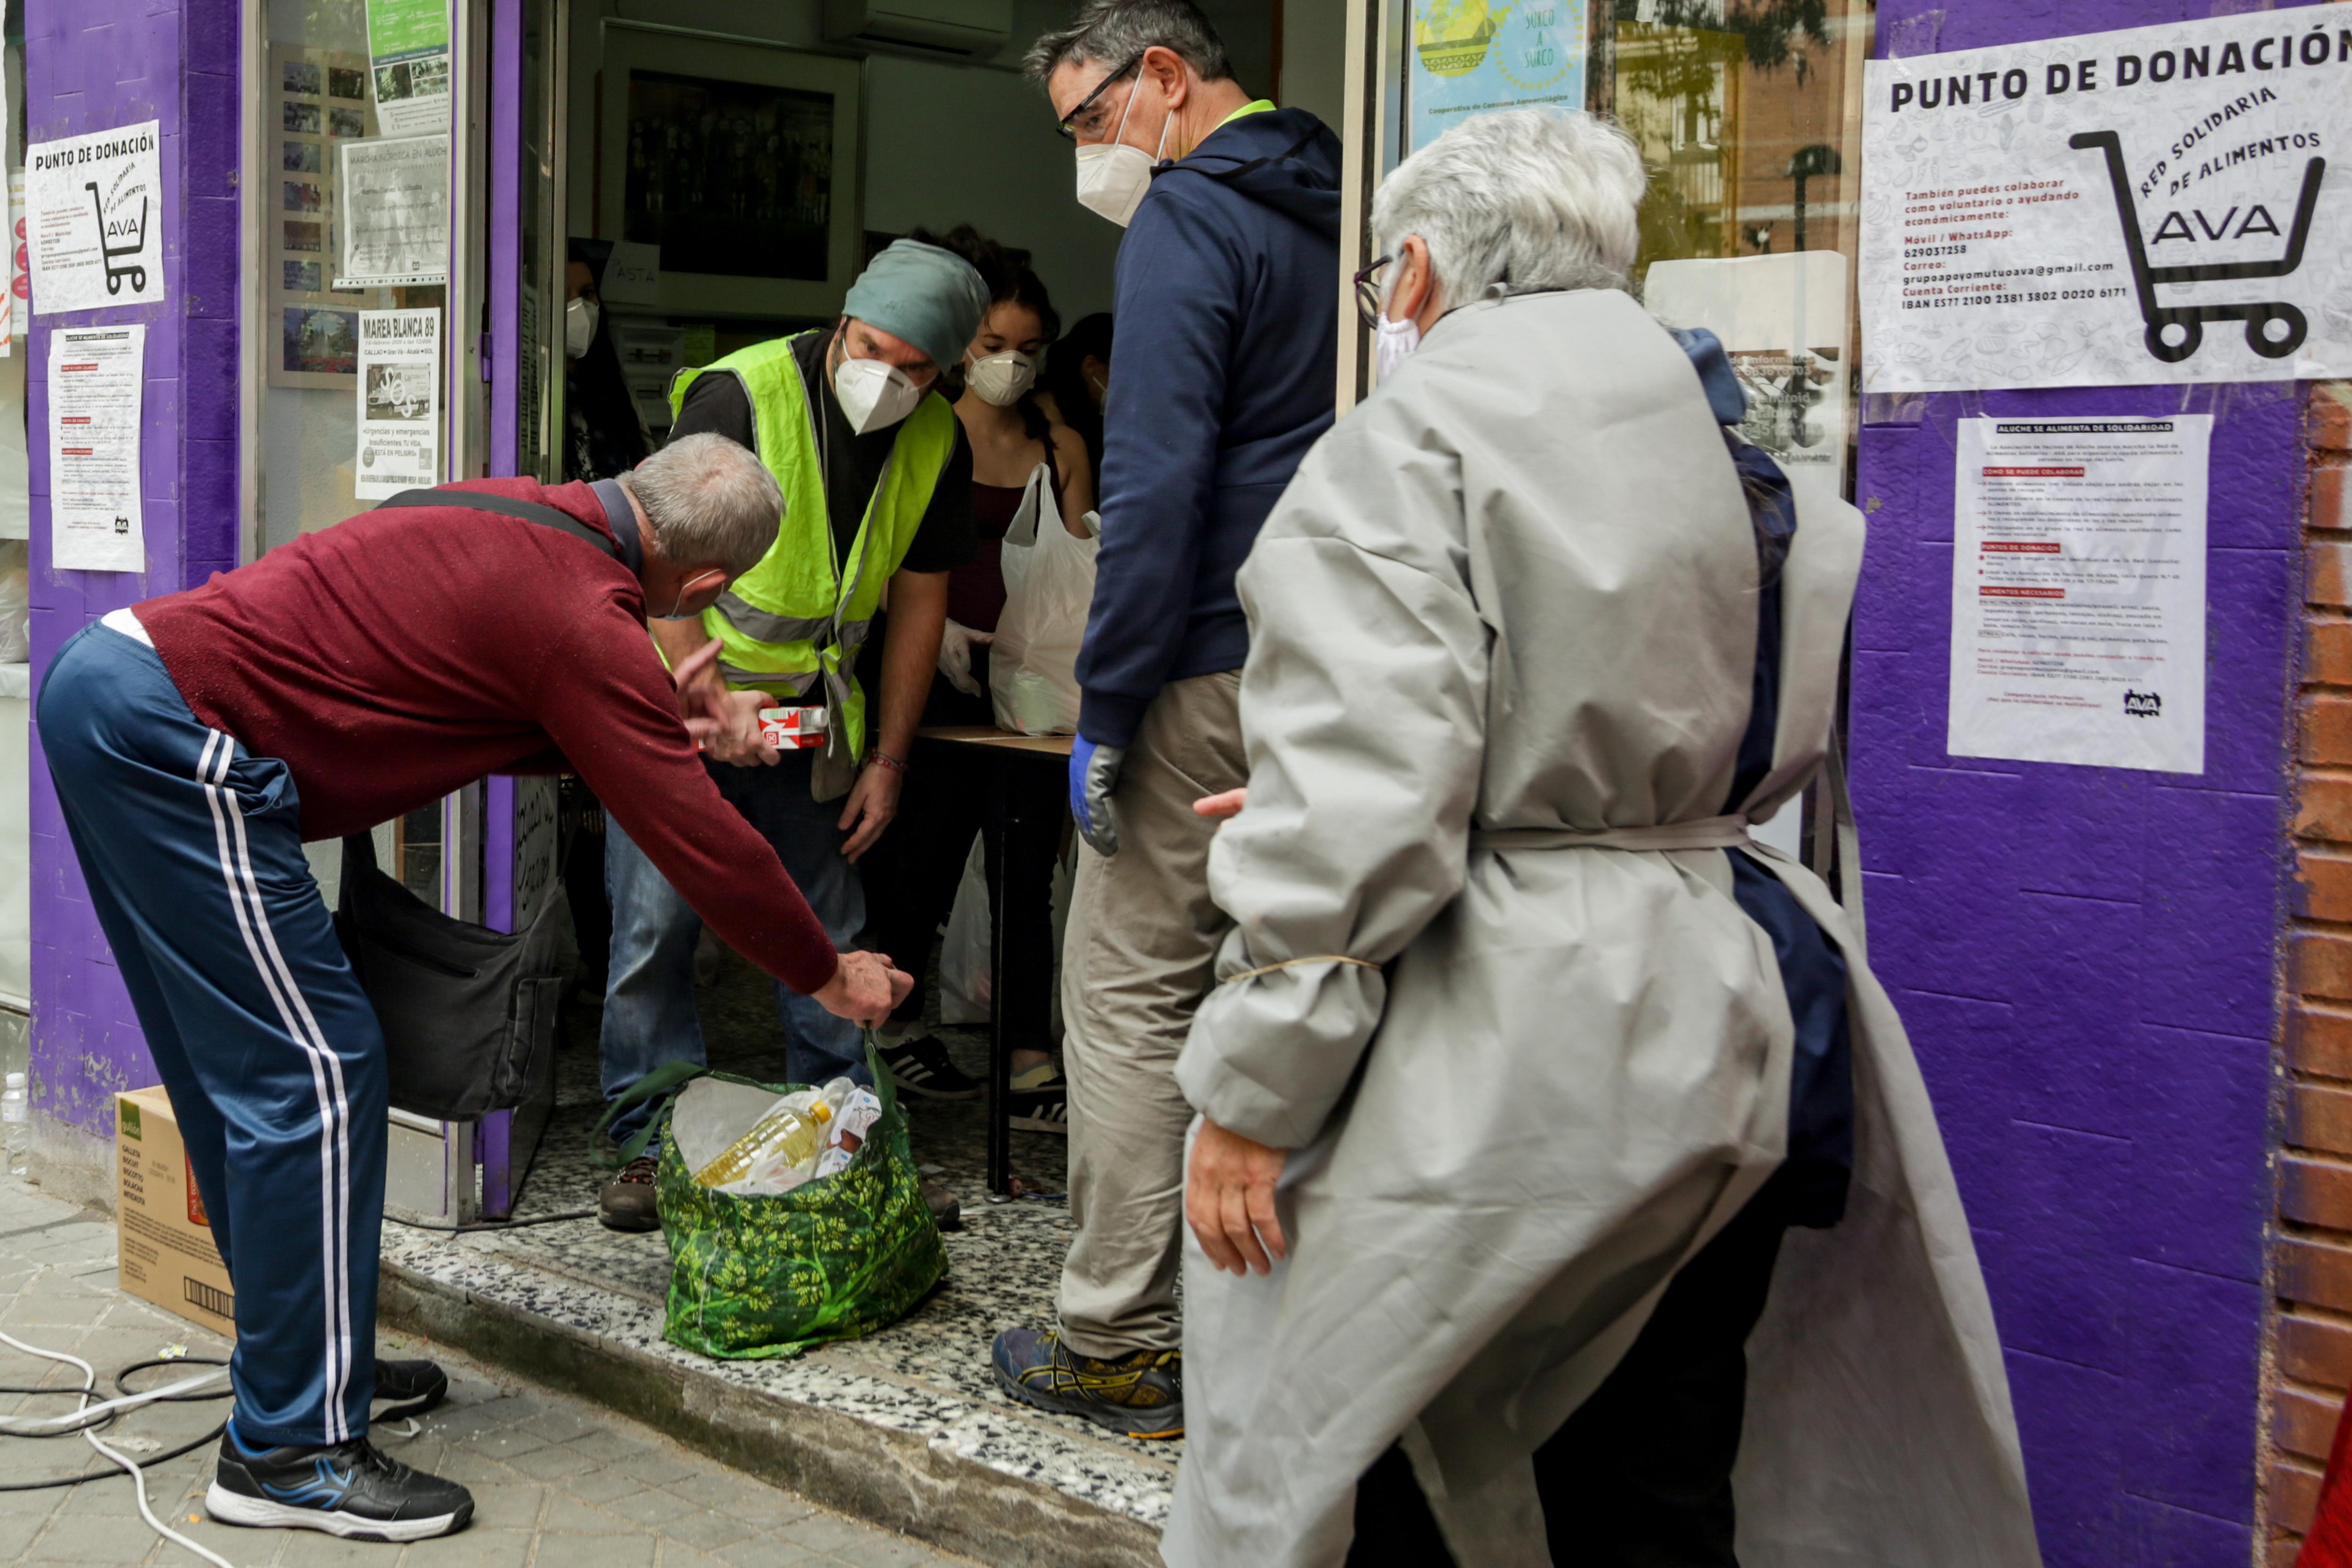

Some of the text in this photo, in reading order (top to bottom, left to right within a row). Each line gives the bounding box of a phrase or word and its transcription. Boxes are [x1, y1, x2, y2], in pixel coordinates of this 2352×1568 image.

[1526, 9, 1554, 29] SURCO
[1537, 31, 1542, 46] A
[1525, 48, 1553, 68] SURCO
[1891, 69, 2027, 113] PUNTO
[2045, 59, 2097, 95] DE
[1429, 105, 1470, 114] Cooperativa
[1483, 100, 1515, 109] Consumo
[1516, 95, 1568, 106] Agroecológico
[36, 132, 154, 171] PUNTO DE DONACIÓN
[2140, 87, 2277, 198] RED SOLIDARIA
[2169, 132, 2320, 197] DE ALIMENTOS
[111, 162, 136, 197] SOLIDARIA
[1906, 179, 2065, 200] También puedes colaborar
[111, 183, 147, 215] DE ALIMENTOS
[1905, 204, 1935, 213] como
[1939, 198, 2002, 210] voluntario
[2018, 191, 2079, 205] ayudando
[107, 218, 139, 239] AVA
[1905, 210, 2009, 227] económicamente:
[2150, 204, 2281, 245] AVA
[1905, 229, 2013, 245] Móvil / WhatsApp:
[1904, 245, 1967, 258] 629037258
[1903, 263, 2113, 286] grupoapoyomutuoava@gmail.com
[1904, 261, 1946, 271] Correo:
[1902, 287, 2127, 310] IBAN ES77 2100 2381 3802 0020 6171
[1903, 283, 2007, 297] Cuenta Corriente:
[364, 317, 434, 338] MAREA BLANCA 89
[2126, 697, 2159, 711] AVA
[122, 1121, 141, 1137] gullón
[122, 1144, 141, 1158] GALLETA
